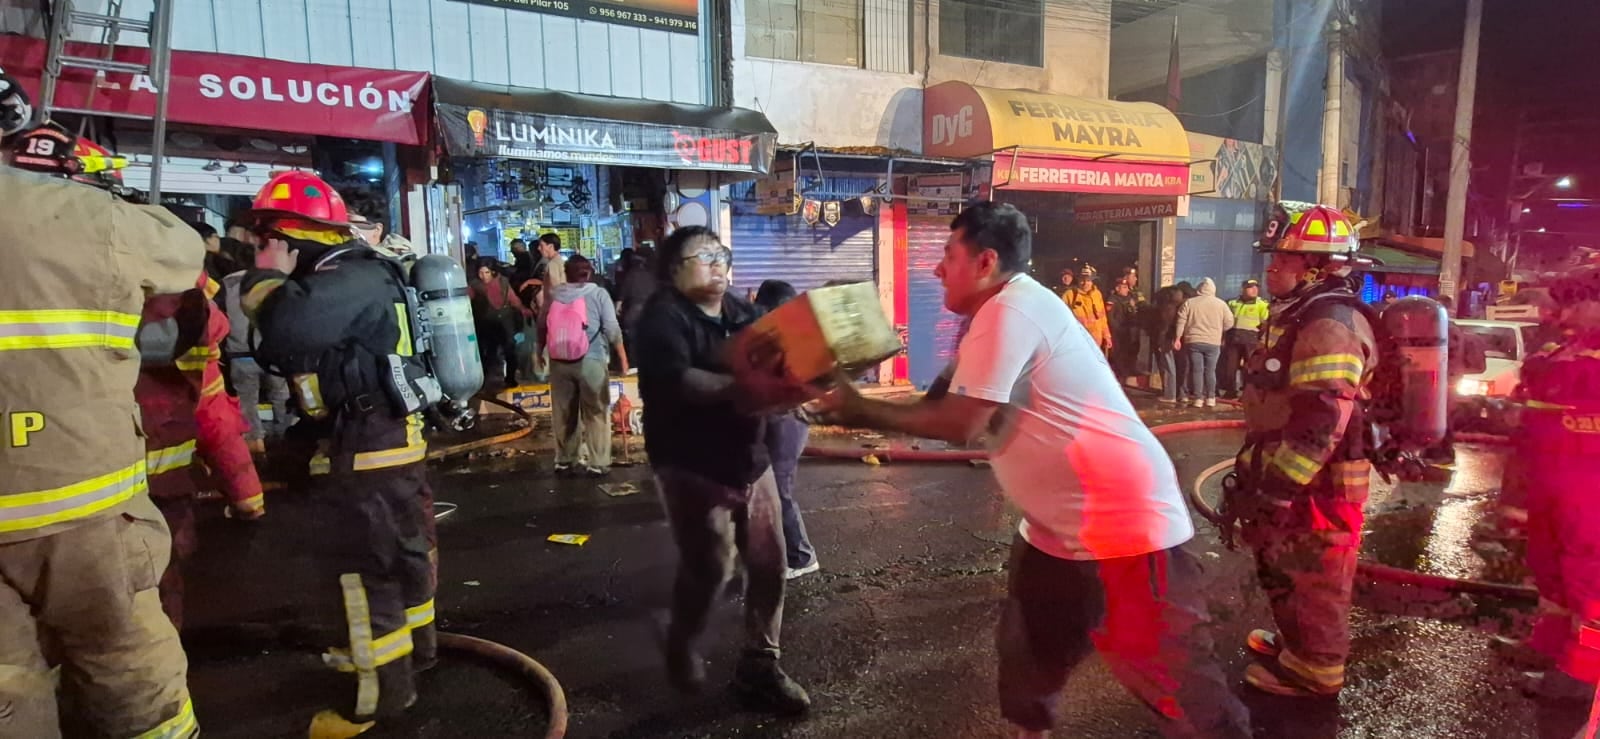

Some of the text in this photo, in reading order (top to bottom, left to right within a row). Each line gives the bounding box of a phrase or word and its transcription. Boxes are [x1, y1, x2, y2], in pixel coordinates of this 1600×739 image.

[530, 0, 551, 8] Pilar
[553, 1, 569, 10] 105
[599, 8, 615, 17] 956
[616, 10, 631, 20] 967
[633, 13, 647, 22] 333
[654, 16, 668, 25] 941
[669, 18, 683, 27] 979
[684, 21, 697, 30] 316
[96, 69, 411, 112] LA SOLUCIÓN
[1008, 100, 1162, 128] FERRETERIA
[932, 104, 973, 146] DyG
[1051, 122, 1142, 147] MAYRA
[26, 138, 55, 156] 19
[498, 144, 568, 161] Iluminamos
[697, 137, 752, 164] GUST
[1020, 167, 1111, 186] FERRETERIA
[1114, 172, 1164, 187] MAYRA
[1134, 204, 1173, 217] MAYRA
[1266, 220, 1279, 238] 9
